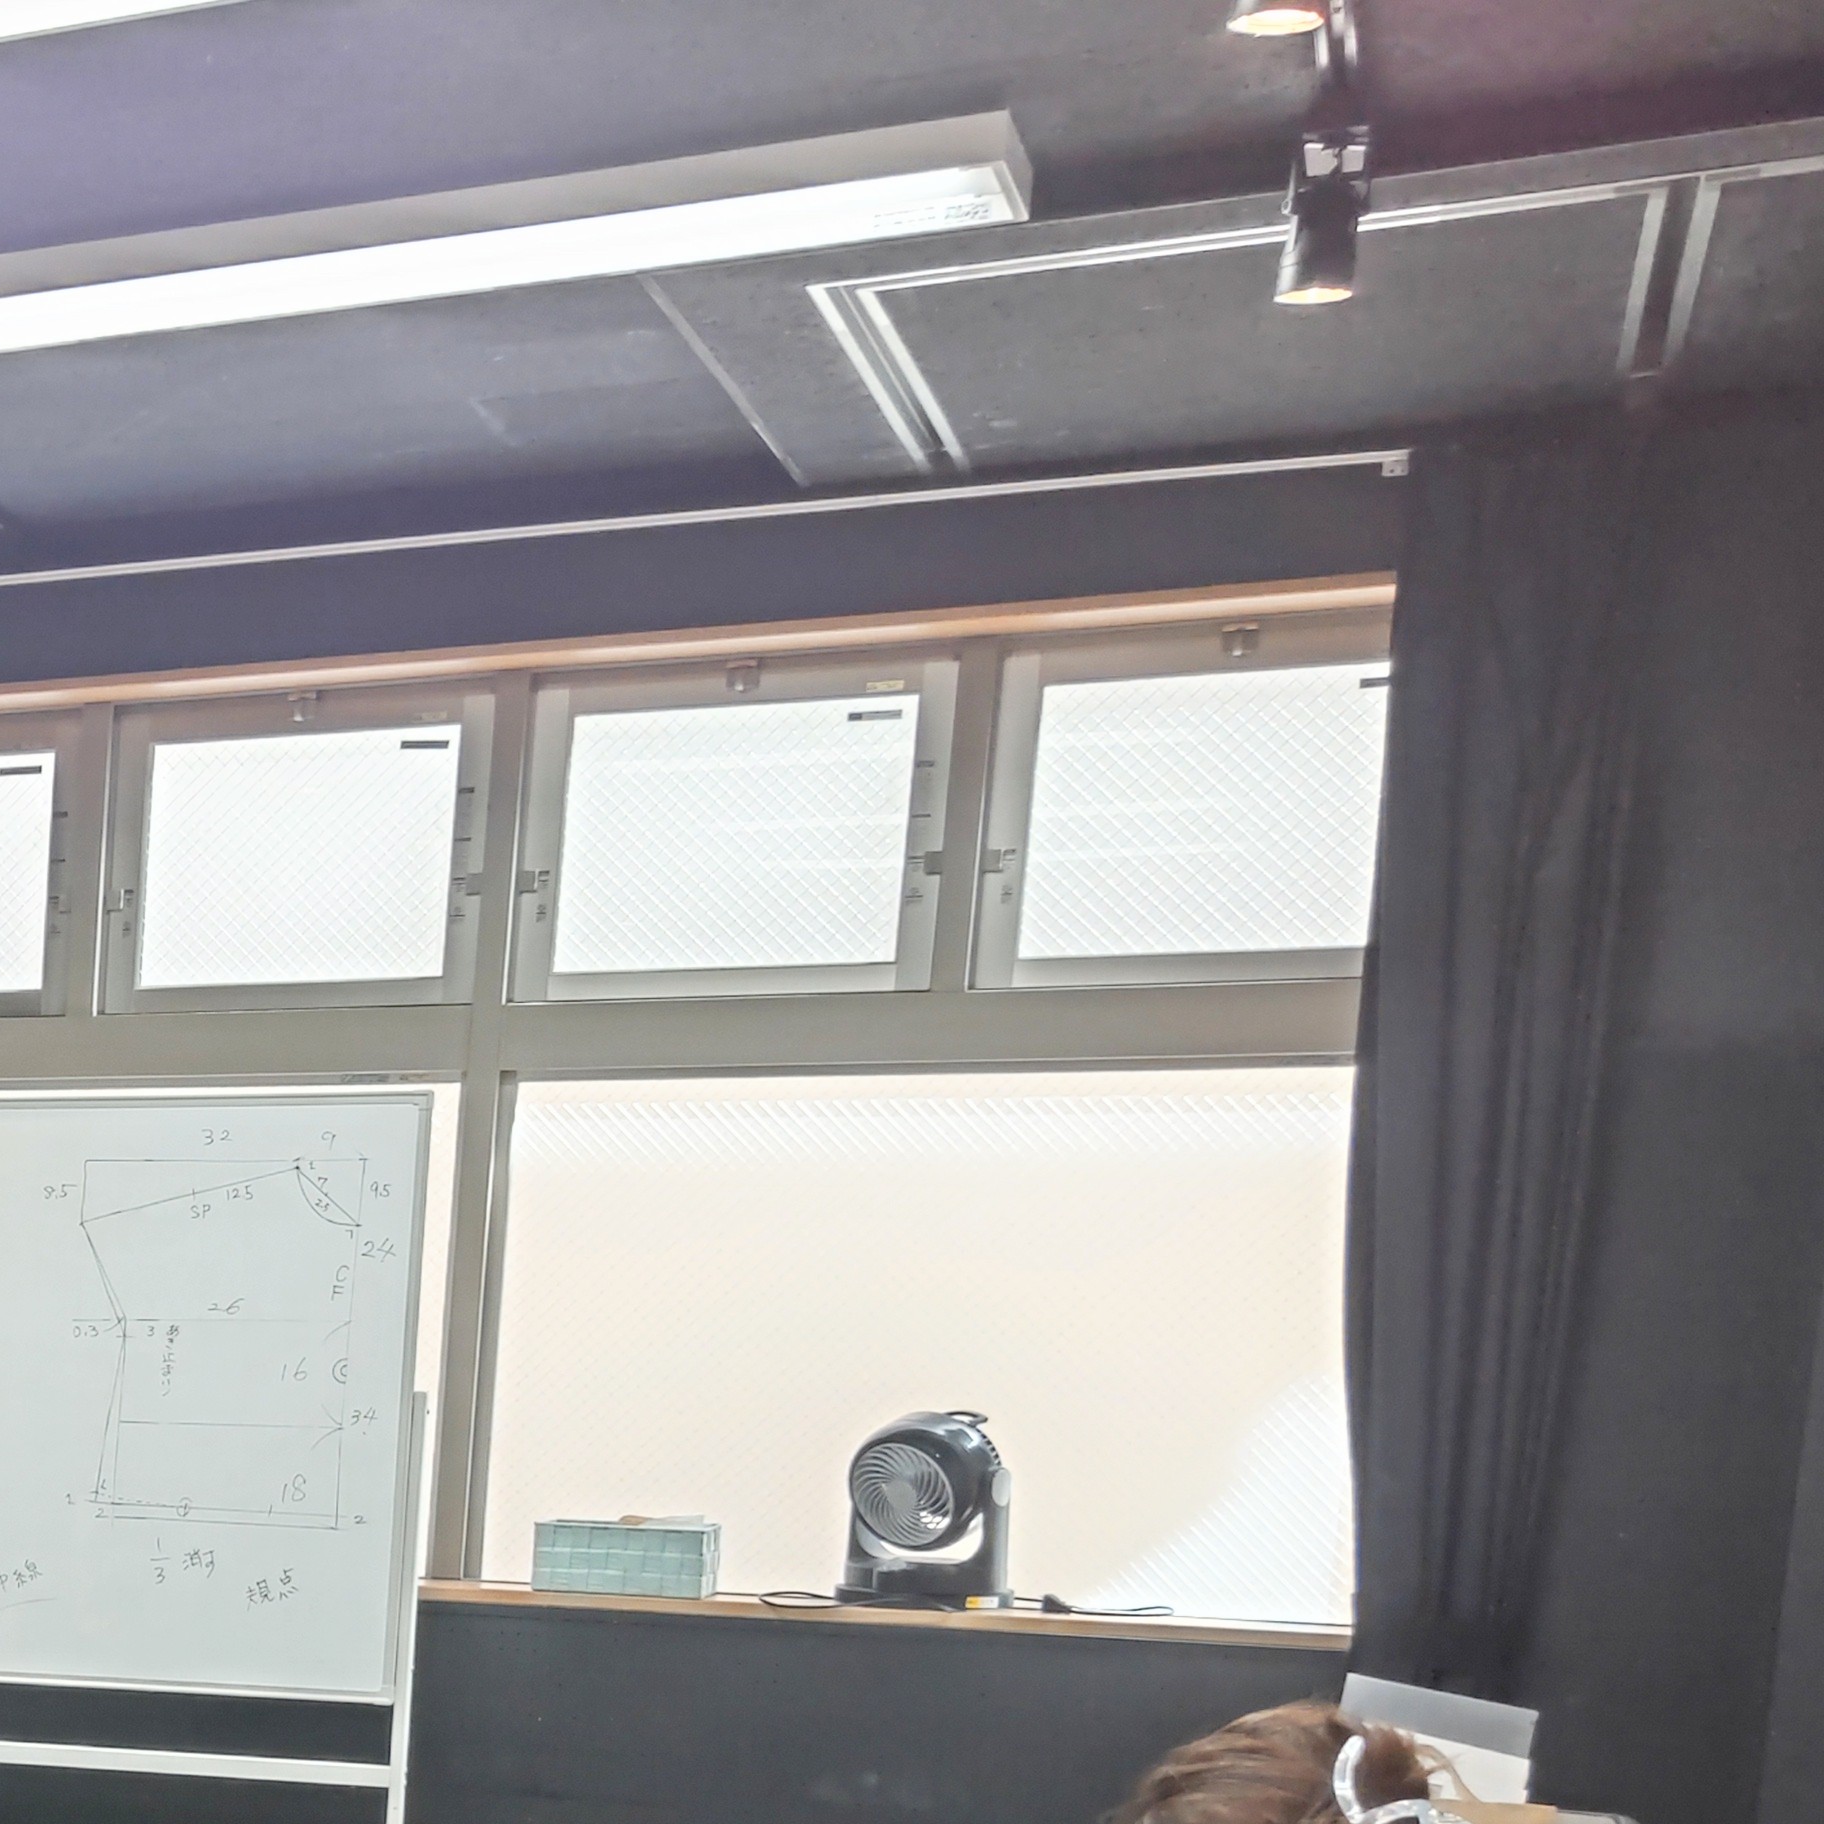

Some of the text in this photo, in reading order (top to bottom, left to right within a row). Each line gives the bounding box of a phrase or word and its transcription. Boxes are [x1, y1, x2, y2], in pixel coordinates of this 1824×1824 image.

[201, 1128, 233, 1146] 32
[320, 1130, 337, 1151] 9
[43, 1183, 78, 1200] 8.5
[190, 1204, 212, 1219] SP
[360, 1237, 397, 1263] 24
[207, 1297, 245, 1316] 26
[72, 1325, 100, 1338] 0.3
[146, 1325, 156, 1338] 3
[281, 1357, 308, 1382] 16
[281, 1473, 307, 1504] 18
[94, 1508, 110, 1519] 2
[353, 1514, 367, 1525] 2
